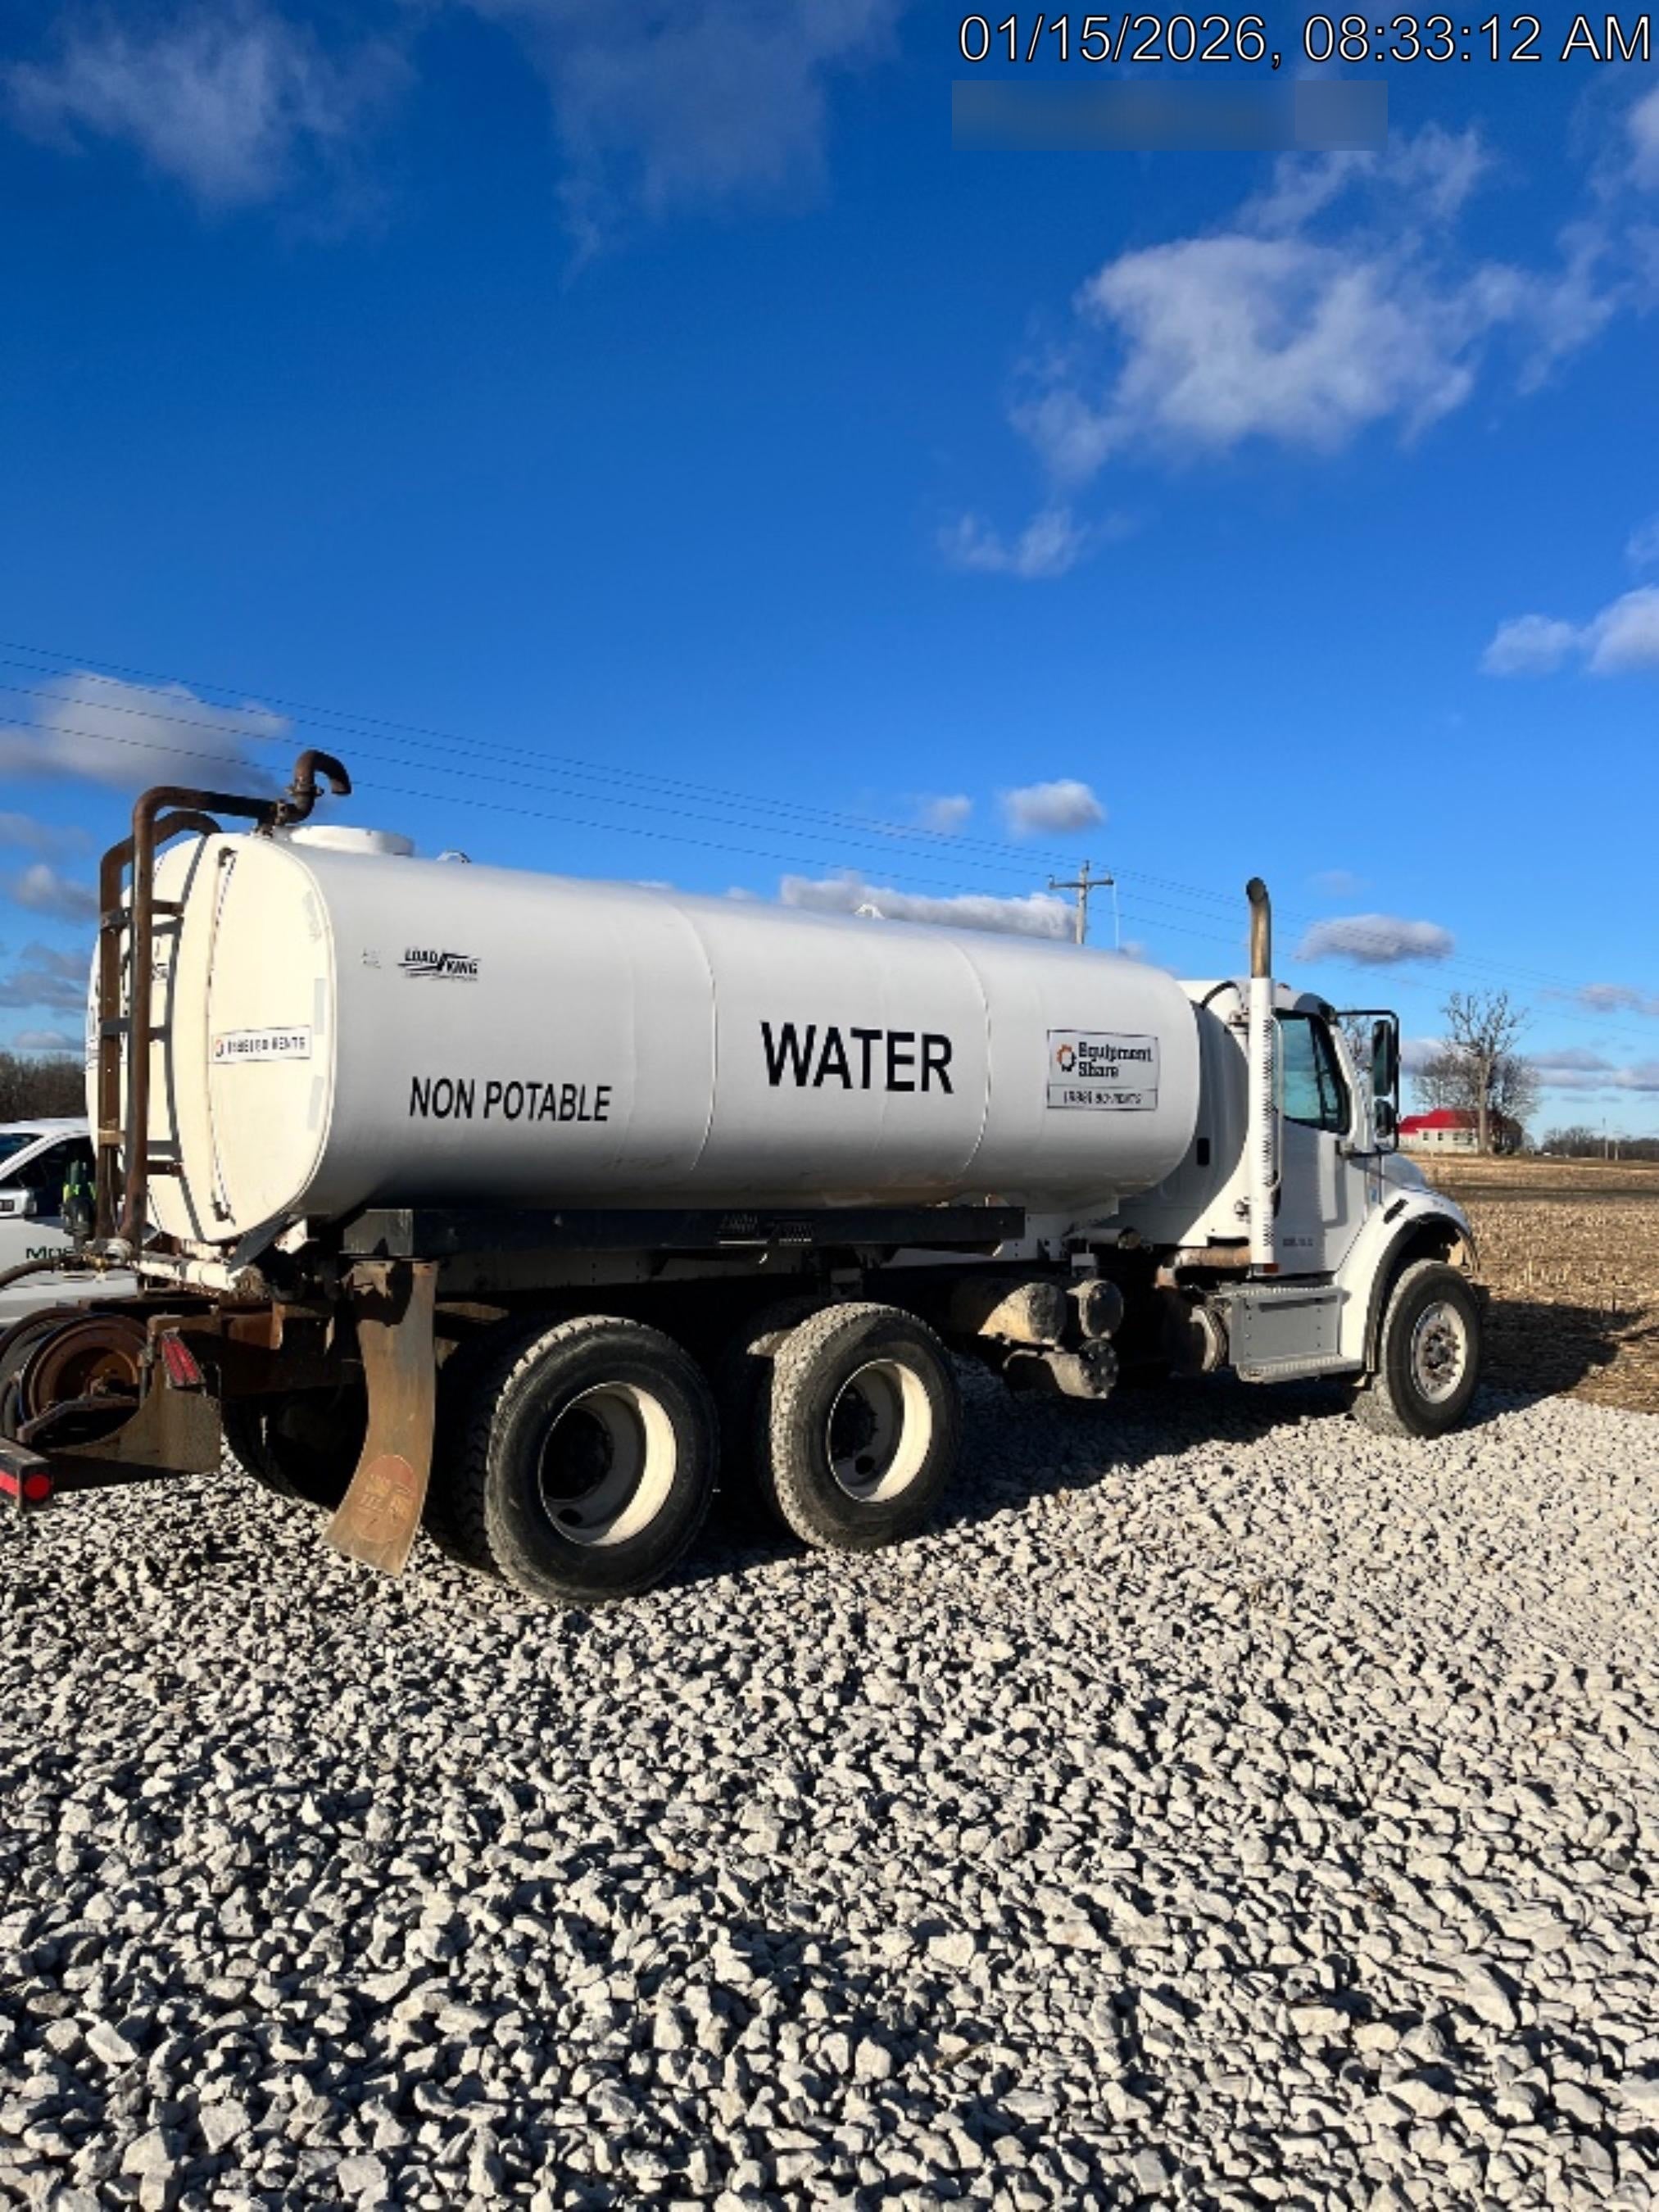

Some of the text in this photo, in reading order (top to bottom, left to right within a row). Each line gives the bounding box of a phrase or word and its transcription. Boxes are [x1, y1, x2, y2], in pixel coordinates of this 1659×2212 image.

[404, 947, 478, 975] LOAD KING
[759, 1021, 954, 1094] WATER
[1078, 1041, 1152, 1063] Equipment
[1078, 1061, 1119, 1078] Share
[410, 1077, 612, 1122] NON POTABLE
